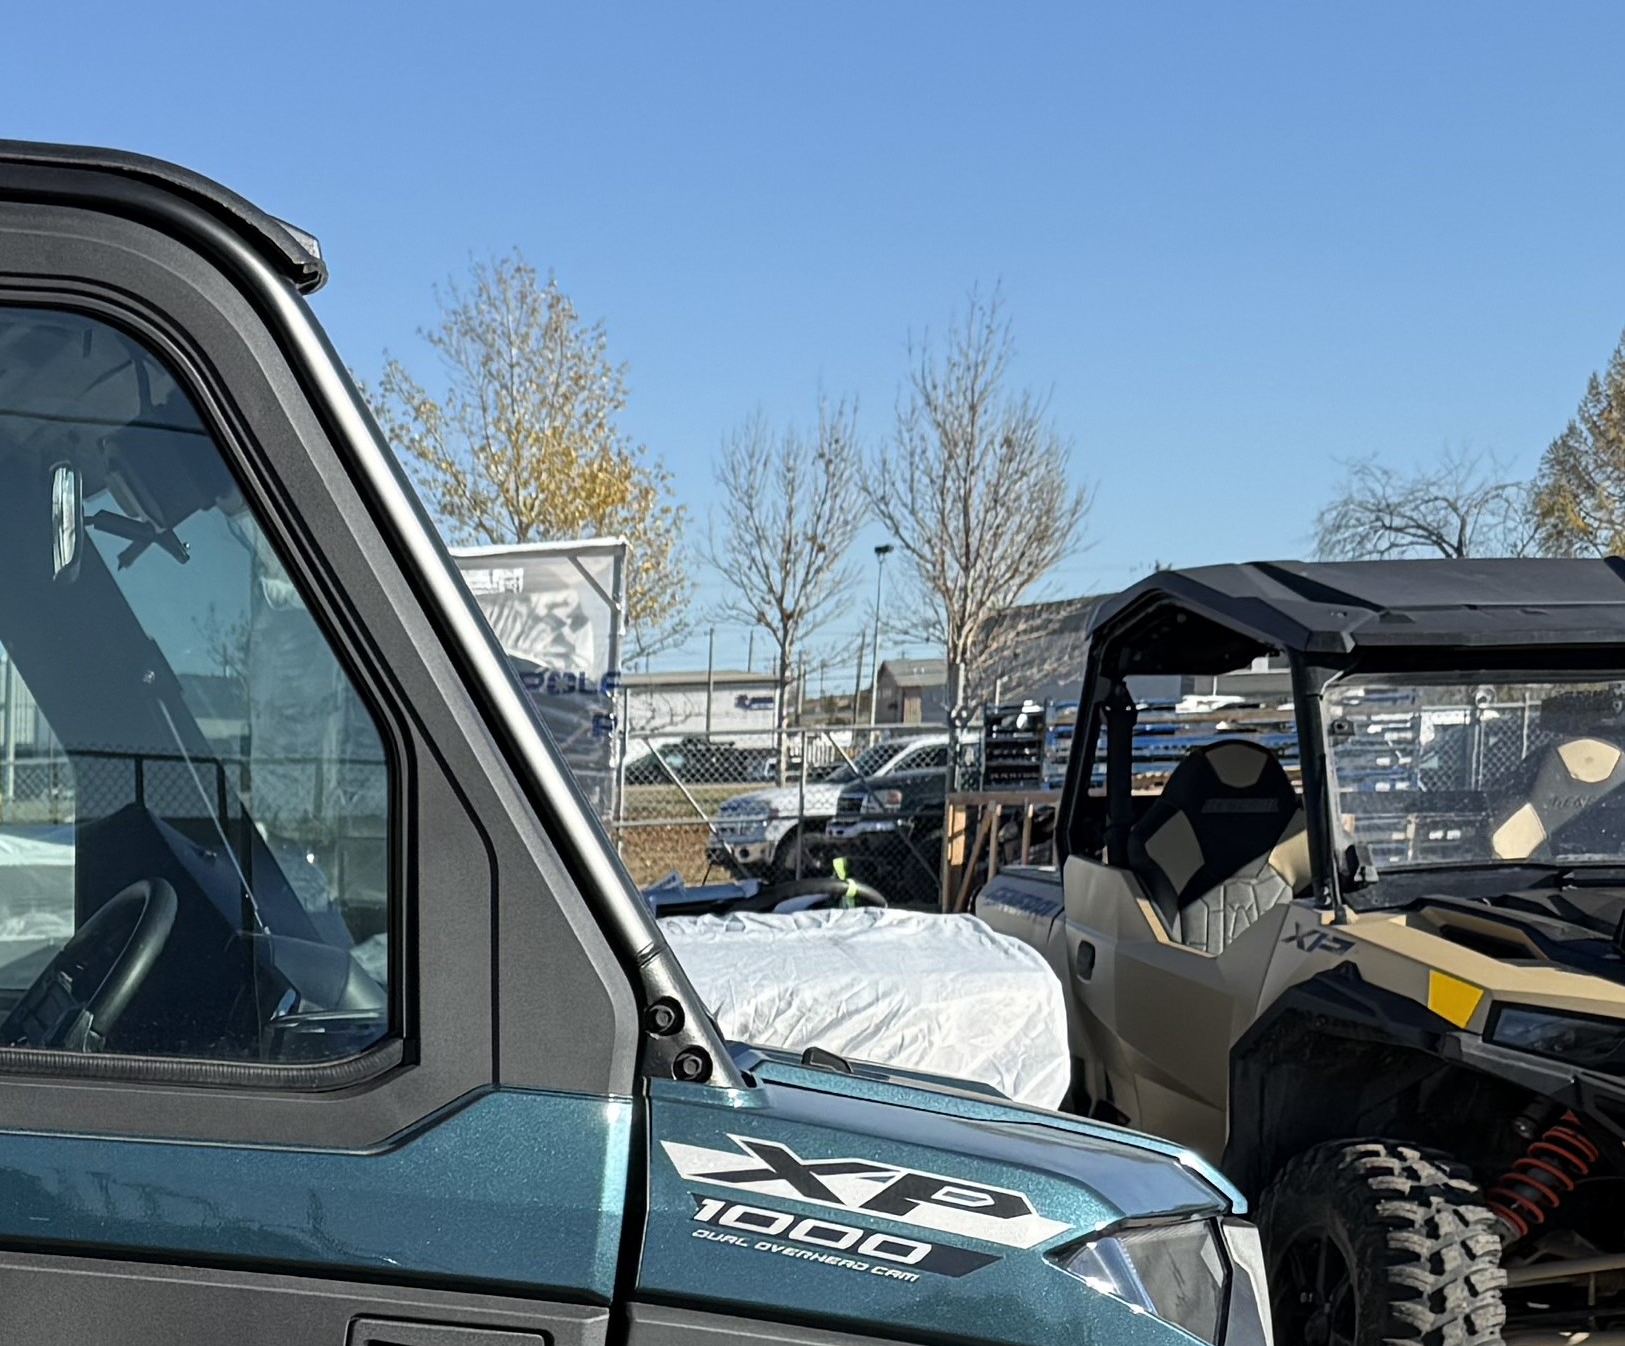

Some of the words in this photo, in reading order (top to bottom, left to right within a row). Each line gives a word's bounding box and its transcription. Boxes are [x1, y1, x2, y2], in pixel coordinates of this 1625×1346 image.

[1281, 921, 1357, 957] XP
[688, 1135, 1041, 1219] XP
[692, 1229, 750, 1248] DUAL
[754, 1241, 870, 1272] OVERHEAD
[871, 1265, 921, 1283] CAM
[693, 1199, 933, 1266] 1000
